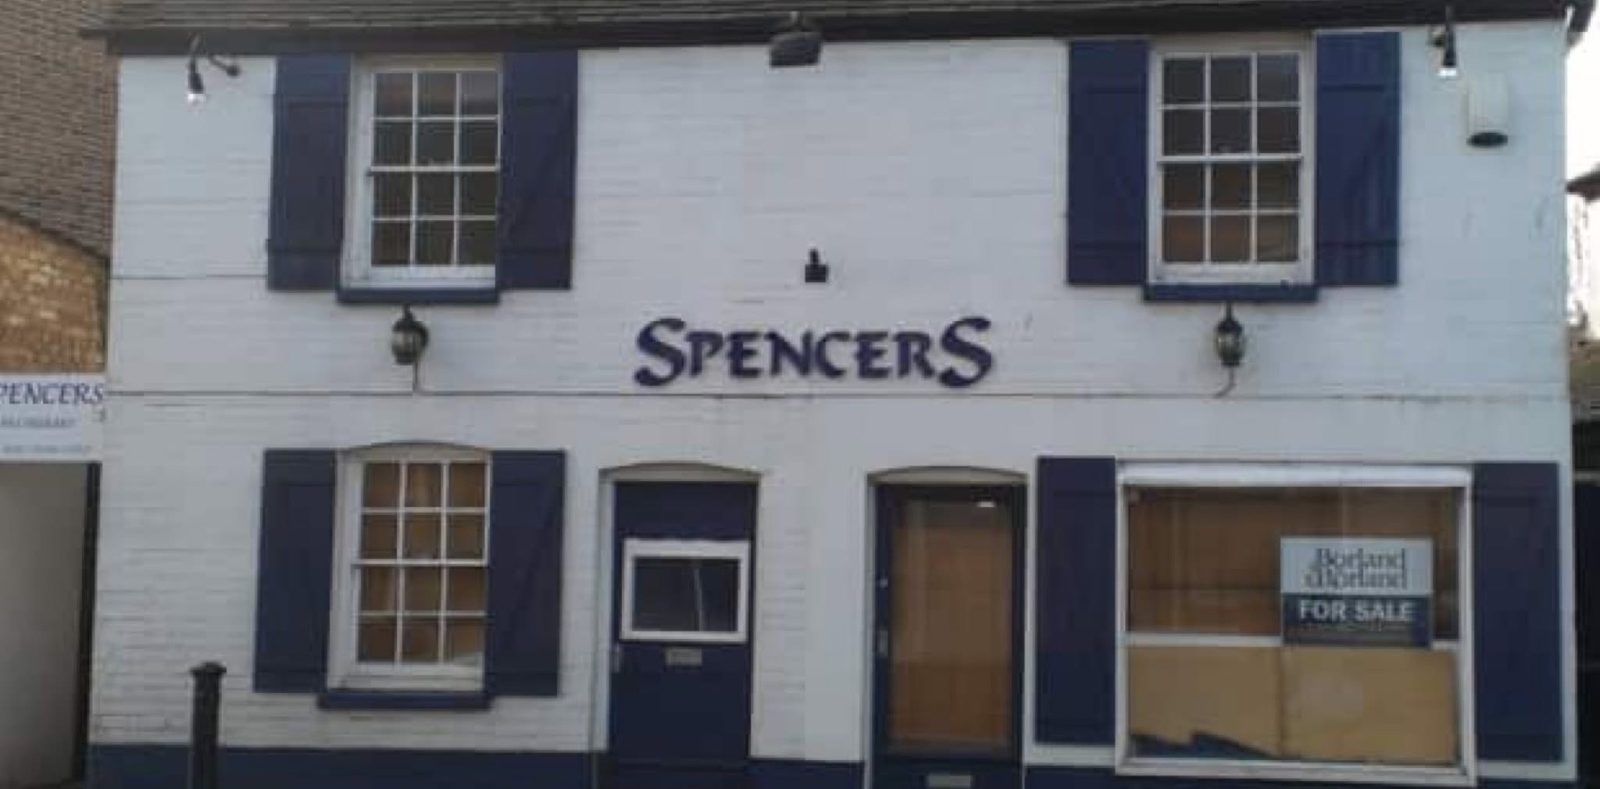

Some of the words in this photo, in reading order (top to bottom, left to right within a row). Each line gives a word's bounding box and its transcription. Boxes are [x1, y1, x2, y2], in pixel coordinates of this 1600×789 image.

[633, 316, 993, 388] SPENCERS
[1299, 599, 1346, 621] FOR
[1355, 599, 1415, 622] SALE
